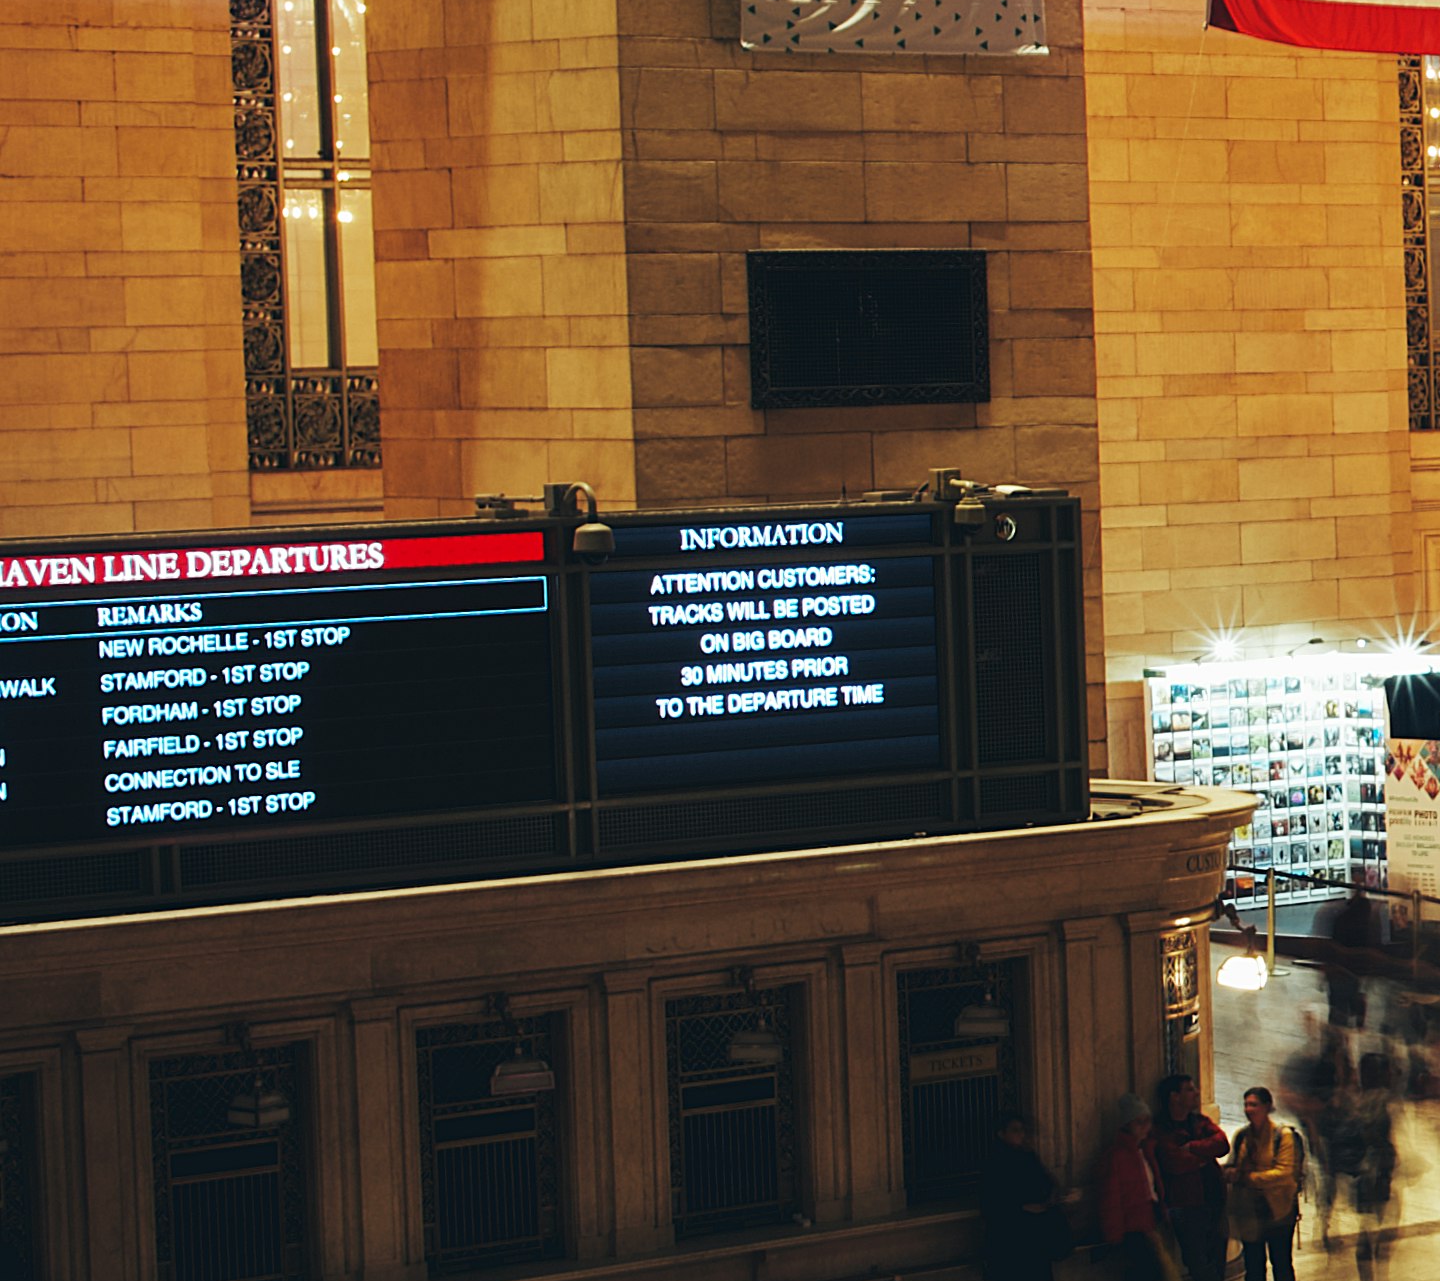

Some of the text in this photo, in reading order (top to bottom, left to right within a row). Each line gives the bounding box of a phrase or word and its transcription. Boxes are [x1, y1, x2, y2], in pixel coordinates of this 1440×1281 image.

[680, 522, 842, 550] INFORMATION
[103, 553, 180, 582] LINE
[186, 542, 384, 578] DEPARTURES
[651, 565, 875, 595] ATTENTION CUSTOMERS:
[97, 602, 202, 626] REMARKS
[648, 595, 874, 625] TRACKS WILL BE POSTED
[99, 627, 349, 658] NEW ROCHELLE 1ST STOP
[700, 628, 832, 653] ON BIG BOARD
[101, 668, 206, 691] STAMFORD
[222, 665, 255, 683] 1ST
[260, 662, 309, 681] STOP
[681, 657, 847, 686] 30 MINUTES PRIOR
[102, 695, 300, 724] FORDHAM 1ST STOP
[656, 684, 883, 718] TO THE DEPARTURE TIME
[104, 728, 302, 758] FAIRFIELD 1ST STOP
[105, 761, 300, 791] CONNECTION TO SLE
[107, 792, 314, 825] STAMFORD 1ST STOP
[929, 1055, 983, 1072] TICKETS
